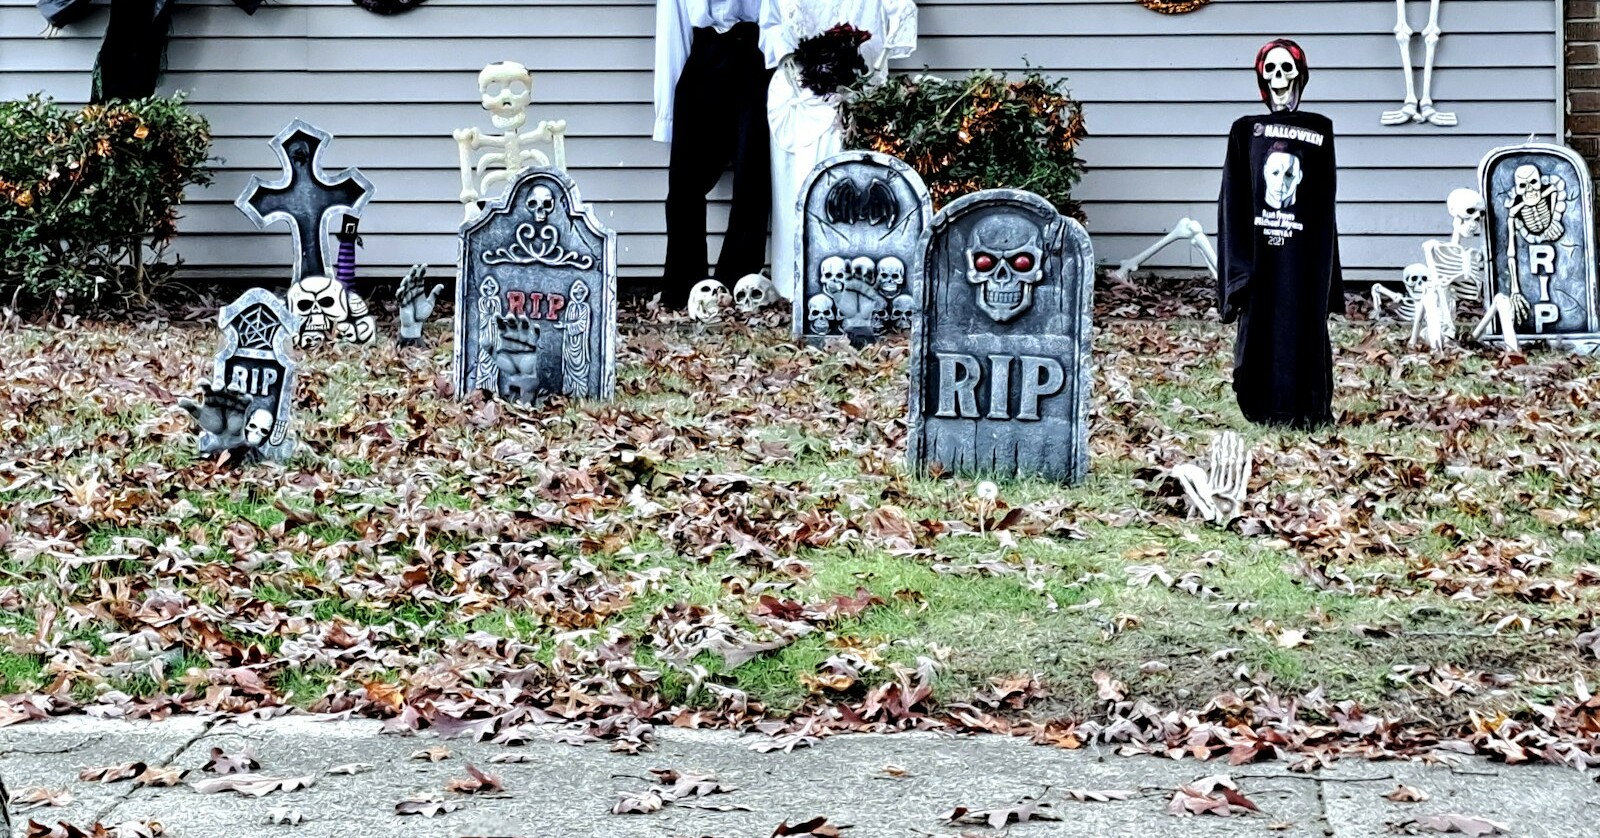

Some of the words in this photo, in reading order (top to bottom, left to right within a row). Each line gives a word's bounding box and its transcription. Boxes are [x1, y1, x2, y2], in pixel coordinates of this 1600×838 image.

[1264, 124, 1324, 146] HALLOWEEN
[506, 291, 565, 320] RIP
[231, 365, 278, 396] RIP
[935, 352, 1064, 421] RIP
